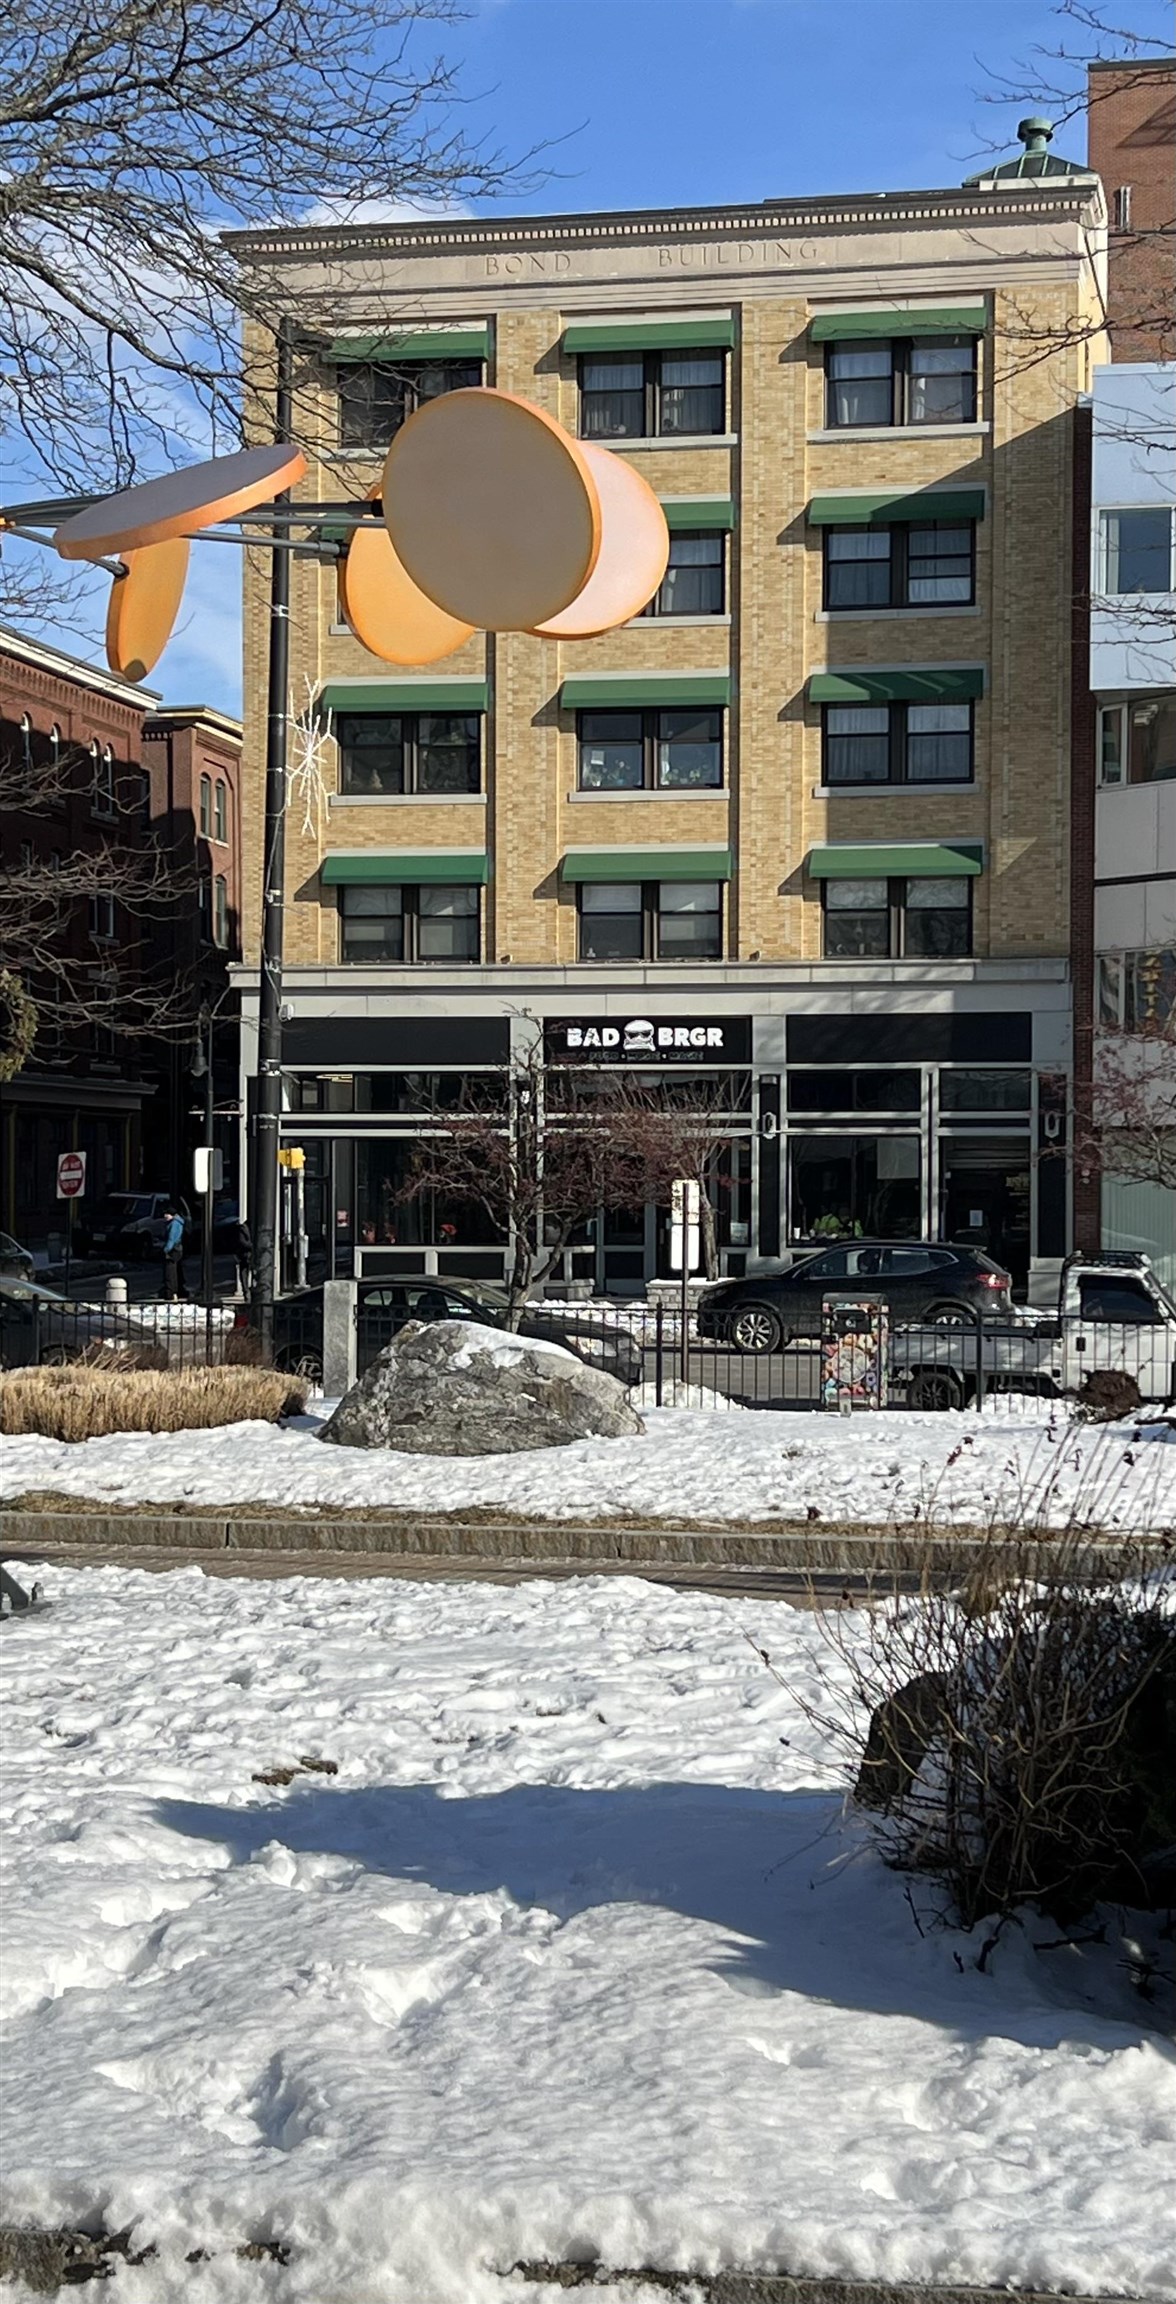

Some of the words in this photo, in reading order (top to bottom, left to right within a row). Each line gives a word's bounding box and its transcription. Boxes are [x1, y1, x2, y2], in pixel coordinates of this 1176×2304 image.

[486, 254, 571, 275] BOND
[658, 240, 818, 267] BUILDING
[567, 1027, 620, 1047] BAD
[658, 1027, 724, 1047] BRGR
